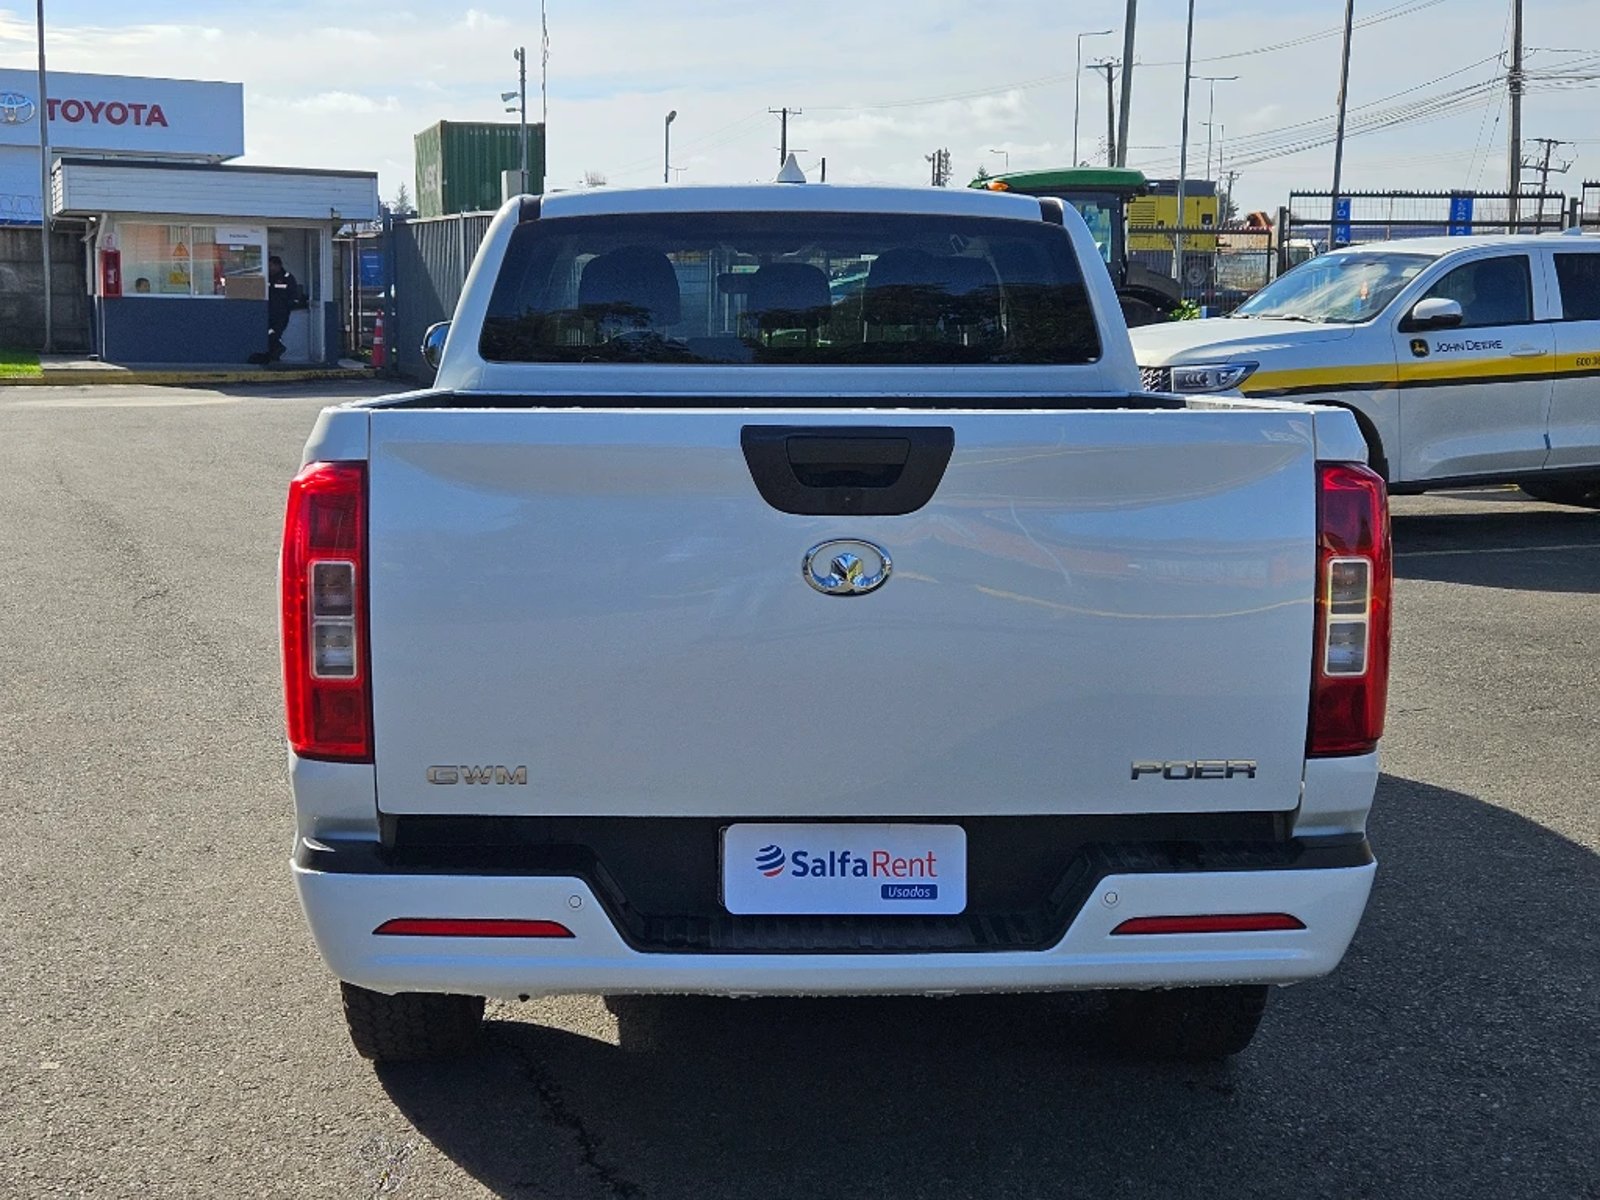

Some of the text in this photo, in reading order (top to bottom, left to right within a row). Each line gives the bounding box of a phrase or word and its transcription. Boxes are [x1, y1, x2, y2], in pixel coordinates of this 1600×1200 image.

[47, 98, 168, 127] TOYOTA
[1435, 340, 1503, 352] JOHN DEERE
[426, 765, 527, 785] GWM
[1131, 760, 1257, 780] POER
[791, 851, 938, 878] SalfaRent
[888, 887, 931, 898] Usados
